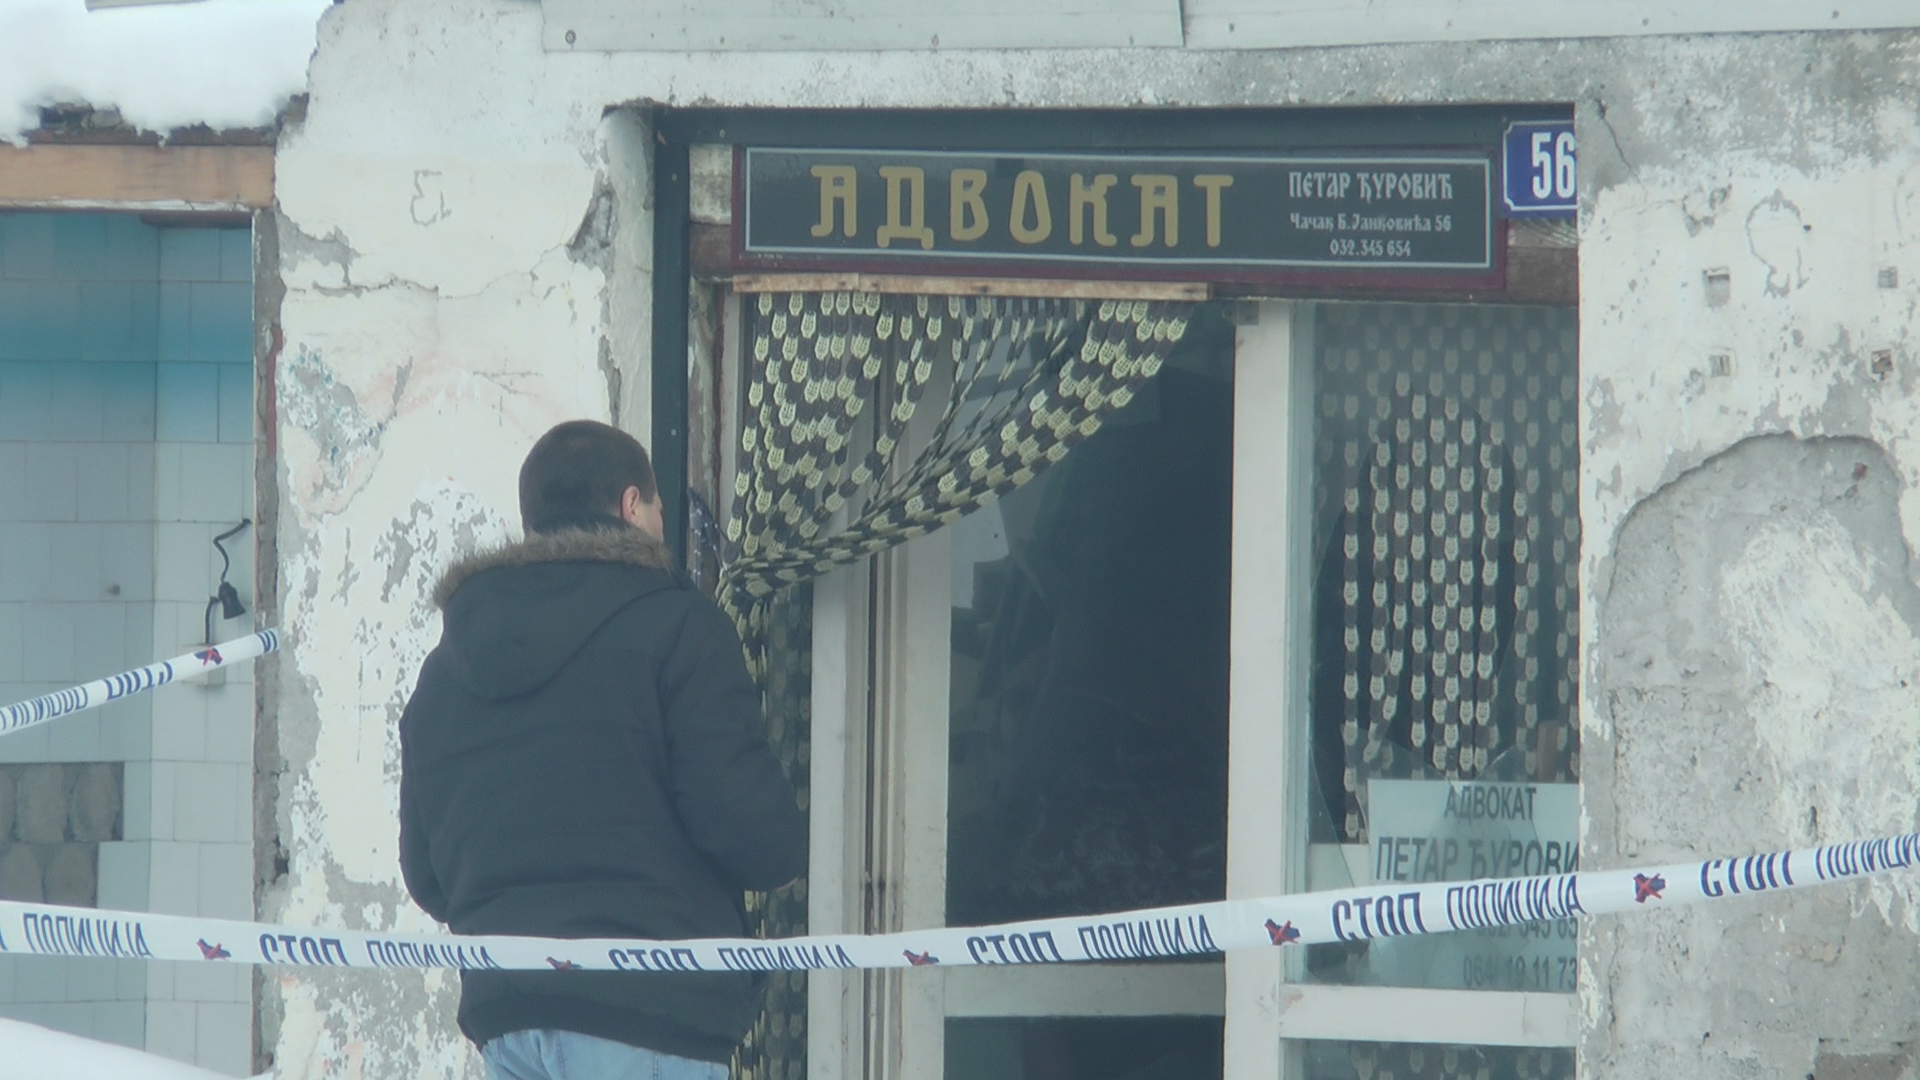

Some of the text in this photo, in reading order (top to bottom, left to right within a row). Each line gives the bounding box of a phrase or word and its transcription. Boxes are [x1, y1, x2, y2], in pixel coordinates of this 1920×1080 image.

[1288, 172, 1350, 199] ПЕТАР
[1532, 132, 1576, 199] 56
[810, 165, 1235, 250] АДВОКАТ
[1290, 212, 1334, 232] Чачак
[1435, 214, 1452, 232] 56
[1386, 239, 1411, 257] 654
[1443, 784, 1538, 824] АДВОКАТ
[1376, 836, 1459, 882] ПЕТАР
[1701, 850, 1795, 898] СТОП
[1332, 875, 1587, 942] СТОП ПОЛИЦИЈА
[22, 912, 155, 958] ПОЛИЦИЈА
[259, 932, 503, 970] СТОП ПОЛИЦИЈА
[607, 944, 859, 971] СТОП ПОЛИЦИЈА
[965, 914, 1223, 964] СТОП ПОЛИЦИЈА
